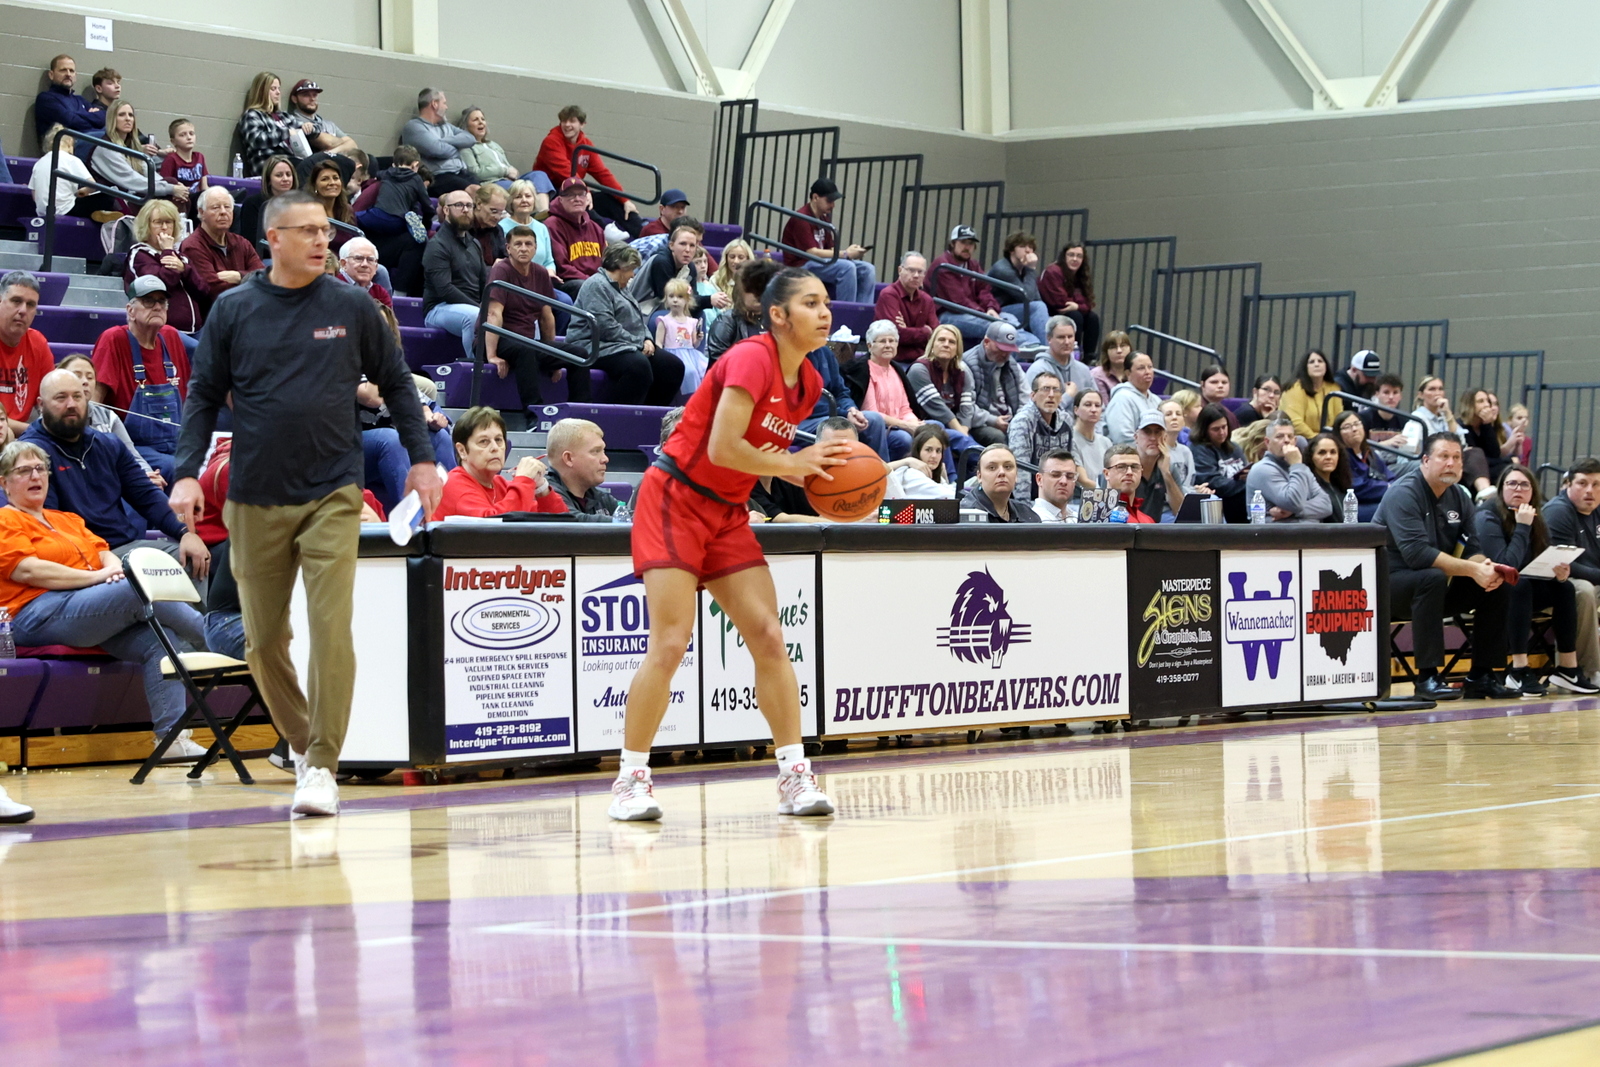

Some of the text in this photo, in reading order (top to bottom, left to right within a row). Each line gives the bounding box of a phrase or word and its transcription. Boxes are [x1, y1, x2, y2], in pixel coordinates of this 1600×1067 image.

[92, 22, 106, 30] Home
[90, 33, 108, 43] Seating
[915, 508, 936, 524] POSS.
[142, 568, 183, 576] BLUFFTON
[444, 564, 567, 595] Interdyne
[1161, 577, 1212, 592] MASTERPIECE
[541, 593, 565, 603] Corp.
[1312, 588, 1368, 611] FARMERS
[480, 610, 531, 619] ENVIRONMENTAL
[1228, 610, 1294, 630] Wannemacher
[491, 622, 520, 630] SERVICES
[1306, 610, 1374, 634] EQUIPMENT
[1137, 589, 1212, 668] SIGNS
[1161, 629, 1198, 646] Graphics,
[1198, 627, 1213, 644] Inc.
[582, 637, 650, 654] INSURANC
[456, 656, 474, 664] HOUR
[475, 655, 514, 663] EMERGENCY
[515, 653, 533, 661] SPILL
[534, 652, 567, 660] RESPONSE
[680, 656, 694, 668] 904
[464, 662, 549, 673] VACUUM TRUCK SERVICES
[583, 658, 640, 673] Looking out for
[467, 671, 546, 682] CONFINED SPACE ENTRY
[1306, 671, 1375, 686] URBANA LAKEVIEW ELIDA
[469, 681, 545, 691] INDUSTRIAL CLEANING
[475, 690, 539, 700] PIPELINE SERVICES
[833, 673, 1122, 722] BLUFFTONBEAVERS.COM
[482, 700, 534, 710] TANK CLEANING
[487, 710, 529, 719] DEMOLITION
[475, 723, 542, 736] 419-229-8192
[602, 728, 613, 736] LIFE
[656, 724, 677, 732] SINESS
[449, 733, 567, 749] Interdyne-Transvac.com
